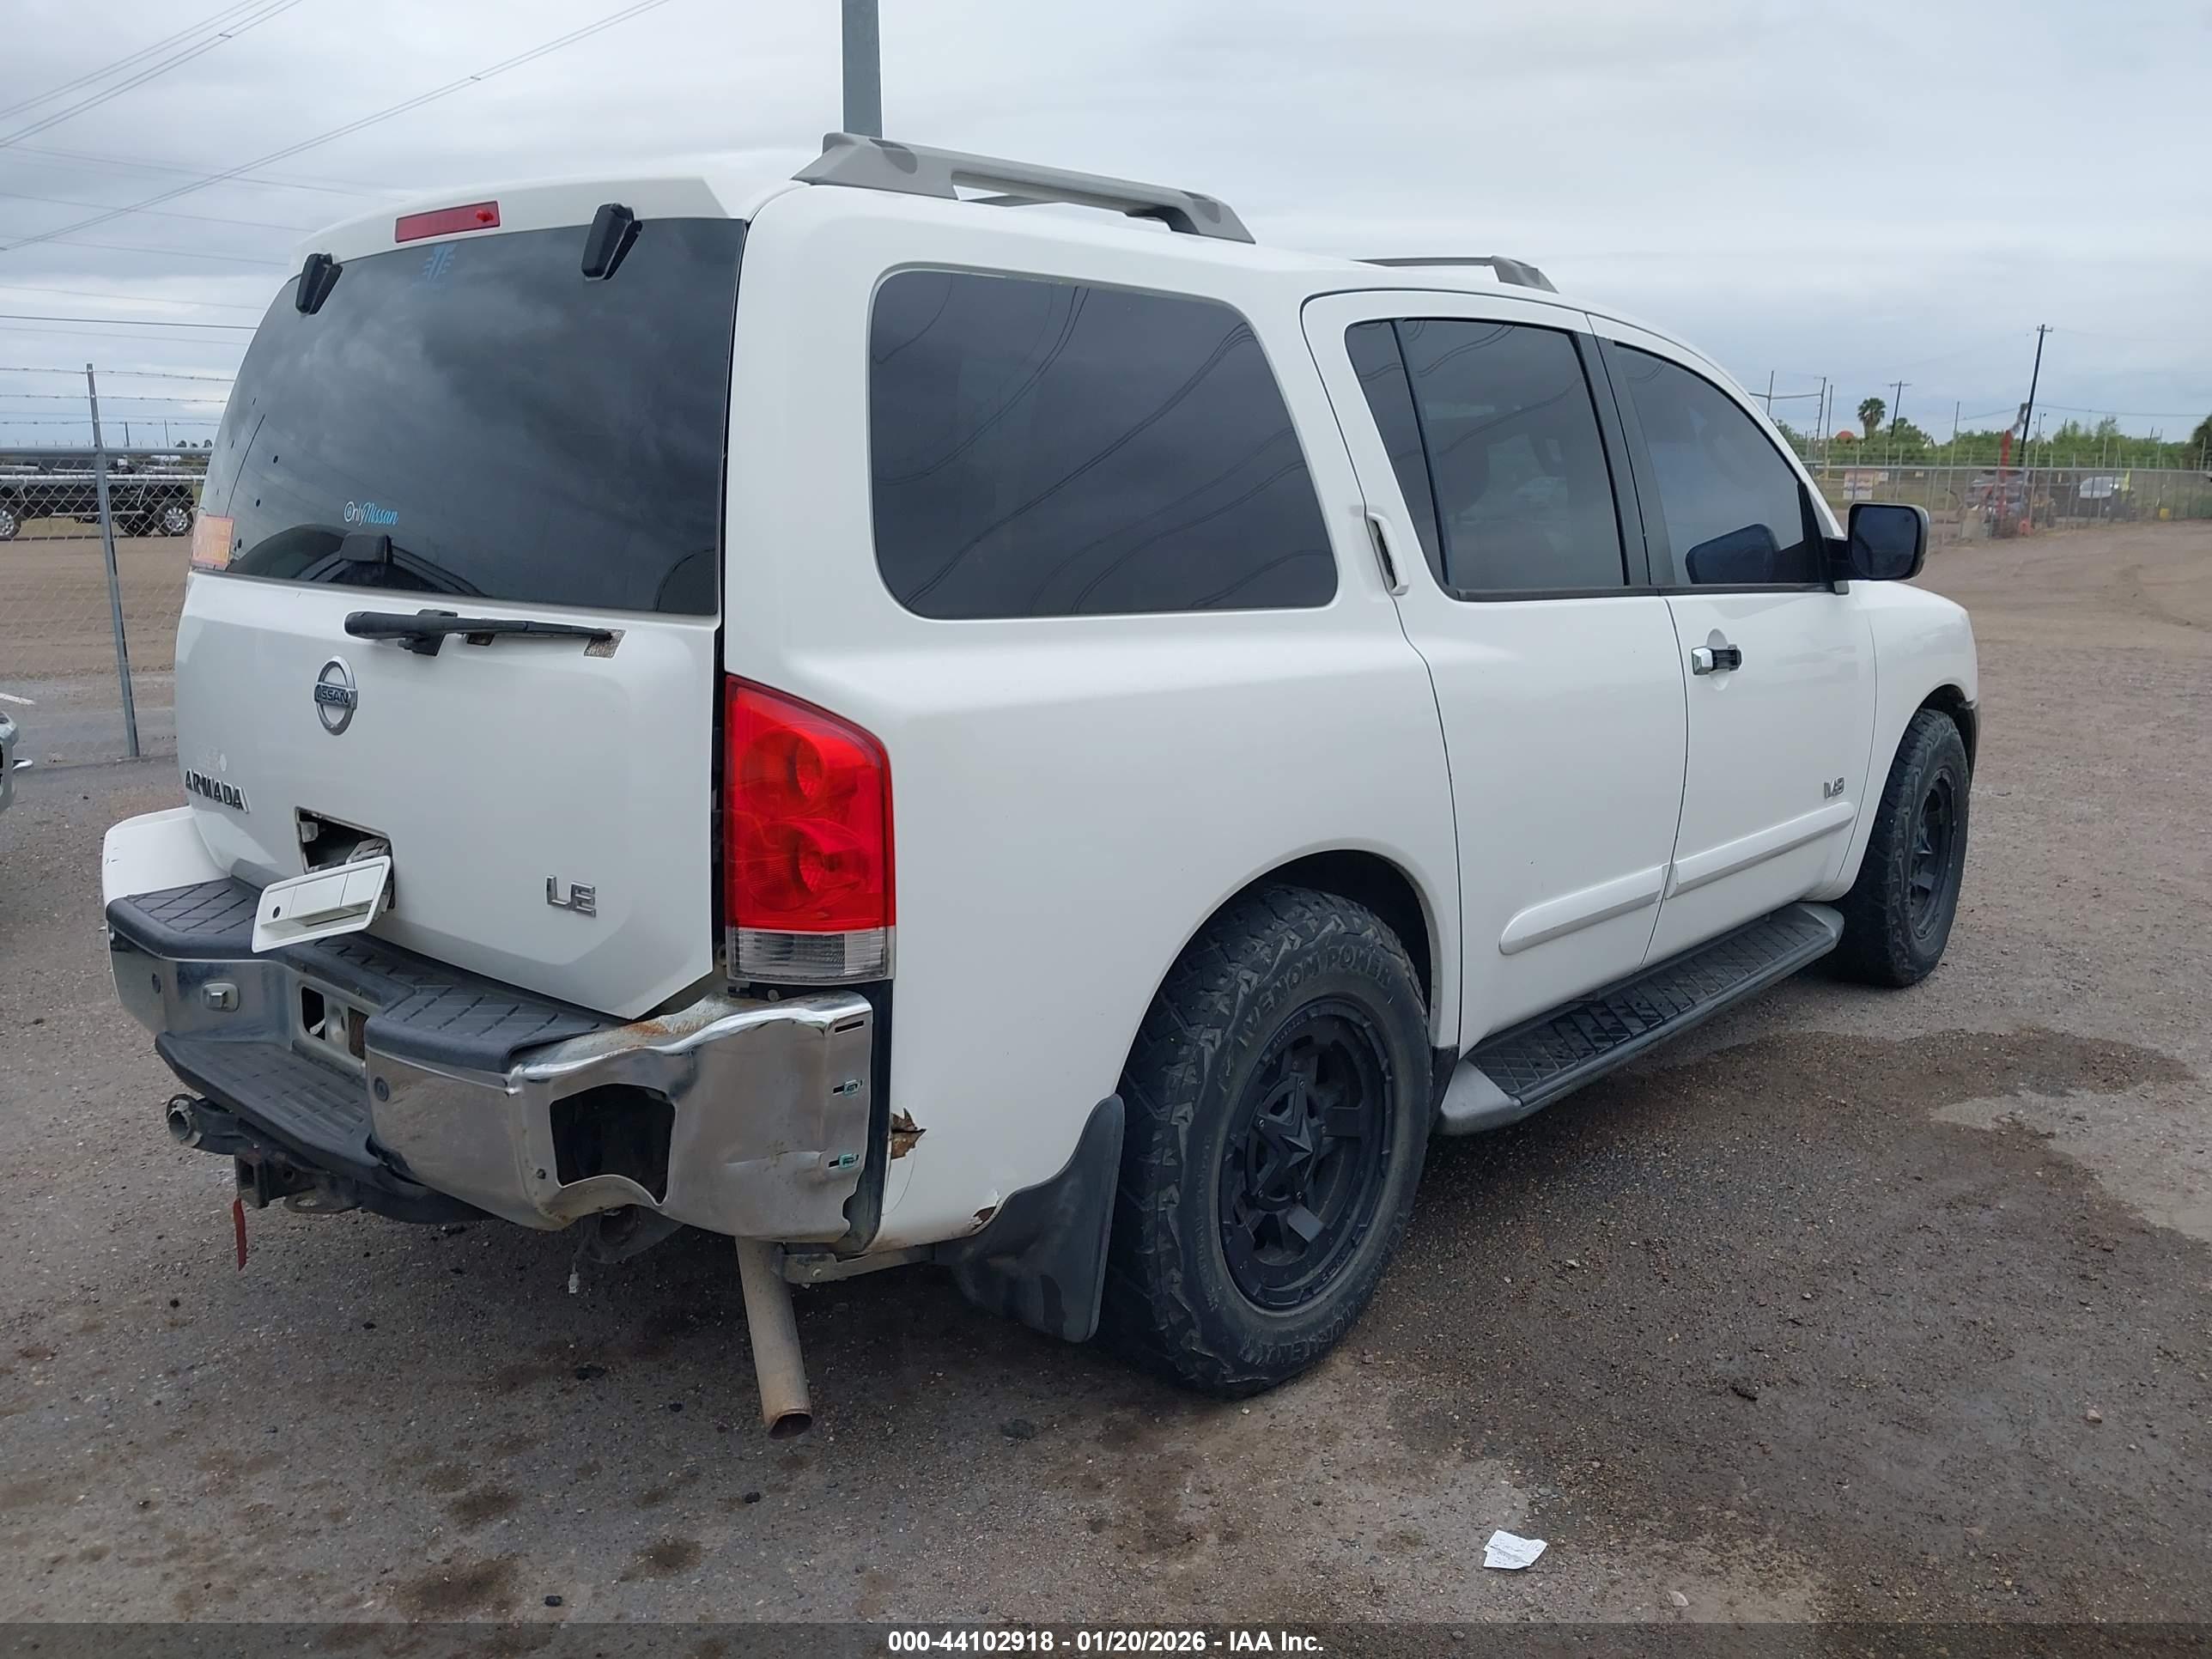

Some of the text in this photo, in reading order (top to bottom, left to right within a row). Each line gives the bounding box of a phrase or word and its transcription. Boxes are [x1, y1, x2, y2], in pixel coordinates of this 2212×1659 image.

[315, 686, 350, 705] NISSAN
[185, 769, 250, 814] ARMADA
[546, 875, 597, 918] LE
